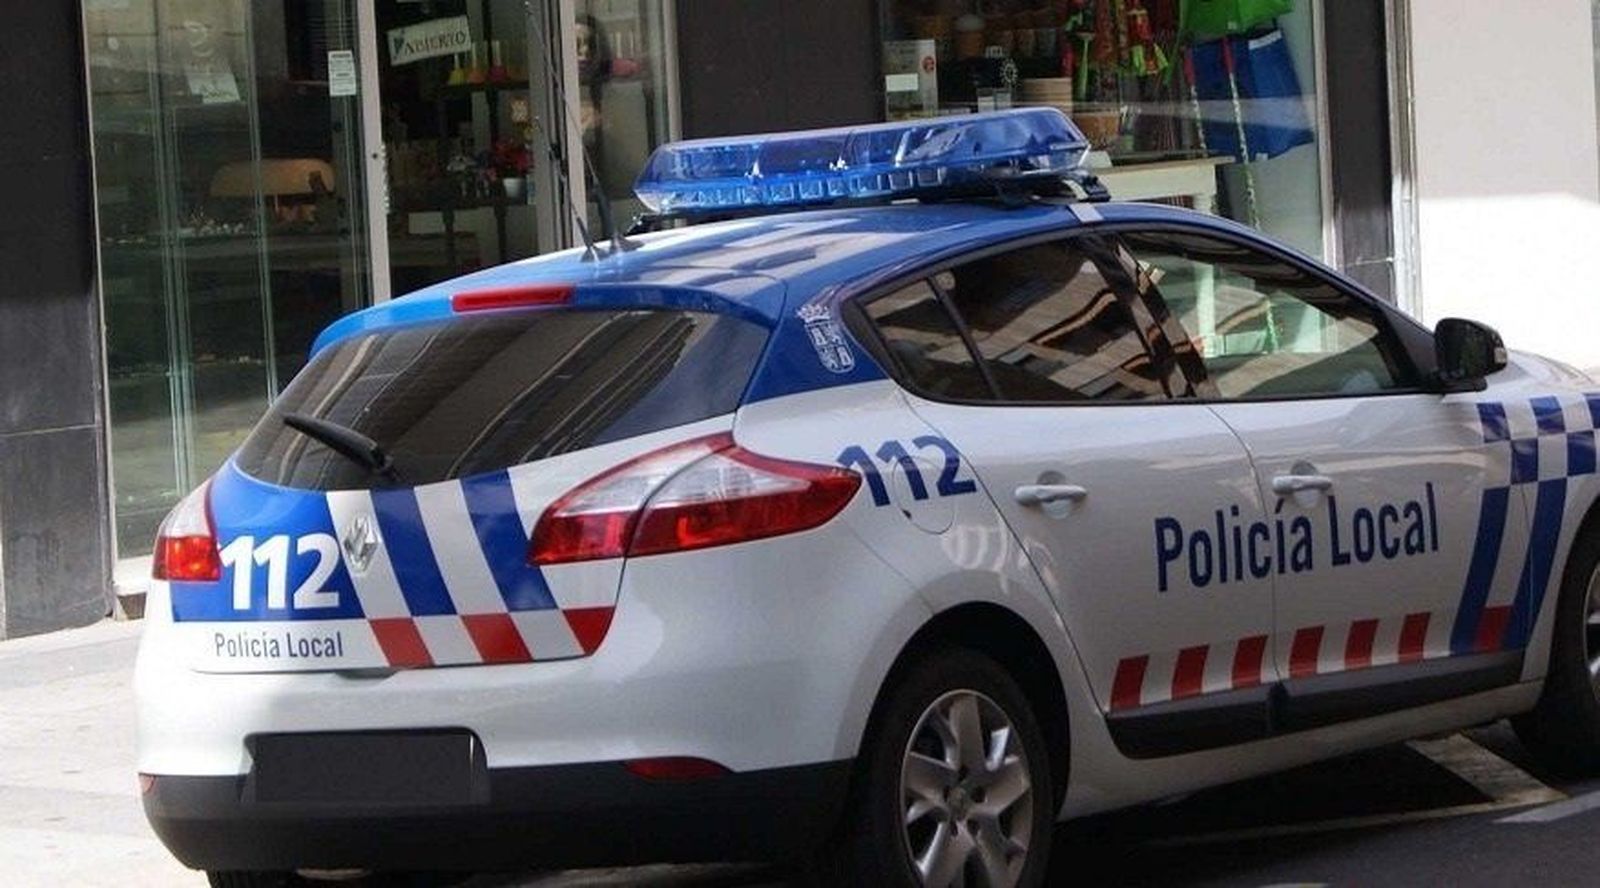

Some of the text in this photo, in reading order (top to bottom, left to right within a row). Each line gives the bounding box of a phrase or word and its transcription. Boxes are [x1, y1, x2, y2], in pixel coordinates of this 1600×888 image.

[837, 435, 977, 507] 112
[219, 533, 340, 610] 112
[1155, 481, 1440, 592] Policía Local
[286, 631, 343, 657] Local
